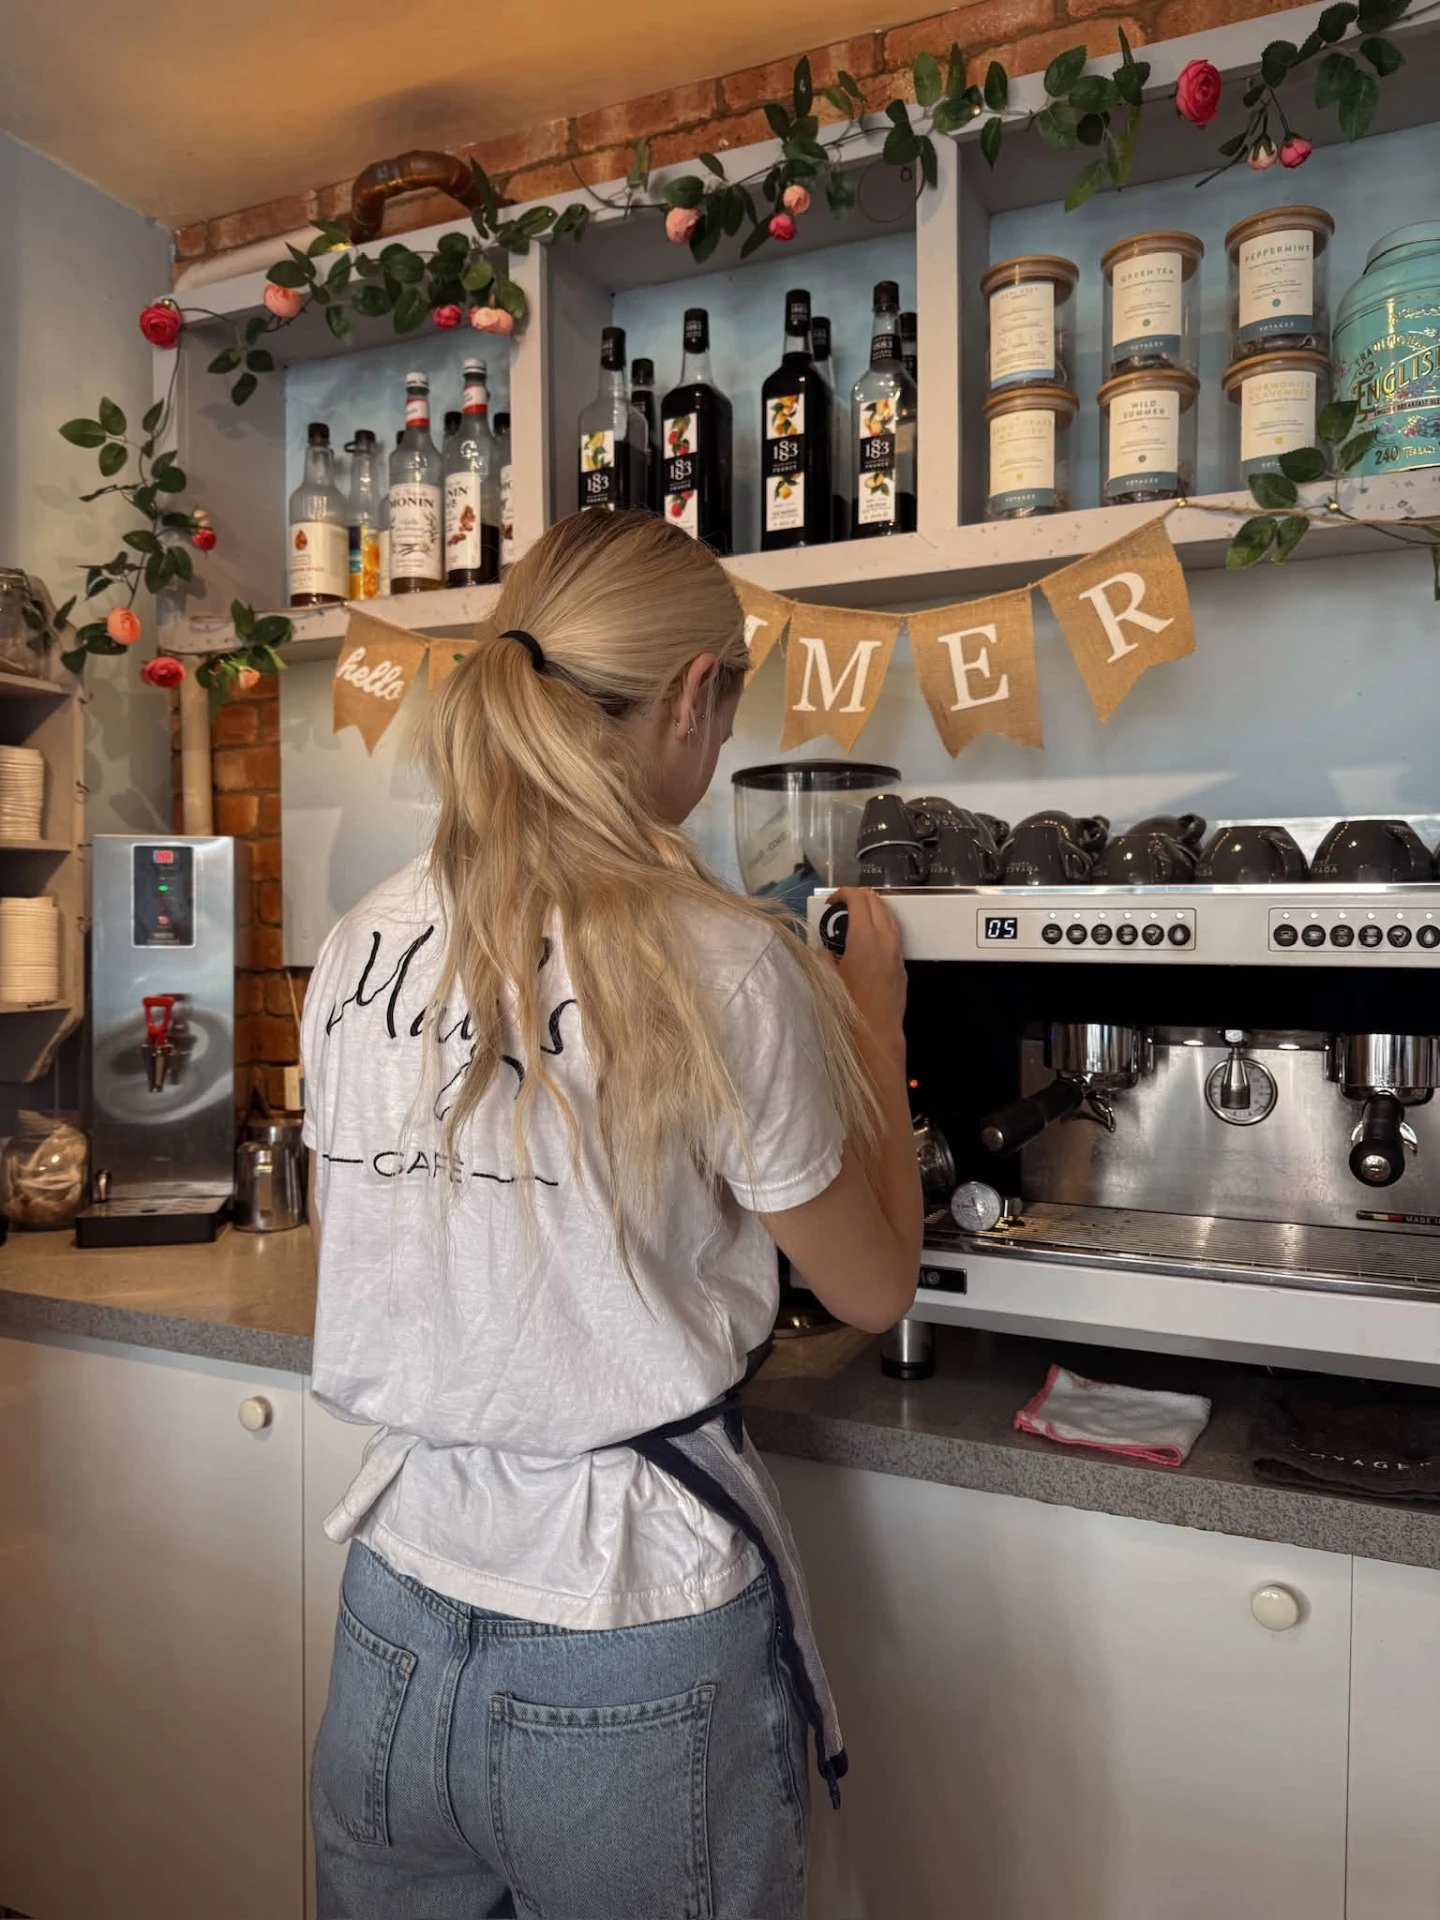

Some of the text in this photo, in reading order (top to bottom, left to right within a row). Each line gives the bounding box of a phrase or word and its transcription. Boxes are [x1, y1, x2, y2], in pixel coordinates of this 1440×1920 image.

[1244, 245, 1310, 263] PEPPERMINT
[1121, 269, 1154, 282] GREEN
[1123, 408, 1165, 419] SUMMER
[1131, 400, 1157, 409] WILD
[773, 440, 798, 461] 1883
[865, 438, 889, 459] 1883
[1374, 445, 1399, 465] 240
[669, 459, 693, 480] 1883
[586, 473, 609, 493] 1883
[336, 646, 405, 701] hello
[988, 919, 1015, 938] 05
[1405, 1215, 1431, 1224] MADE
